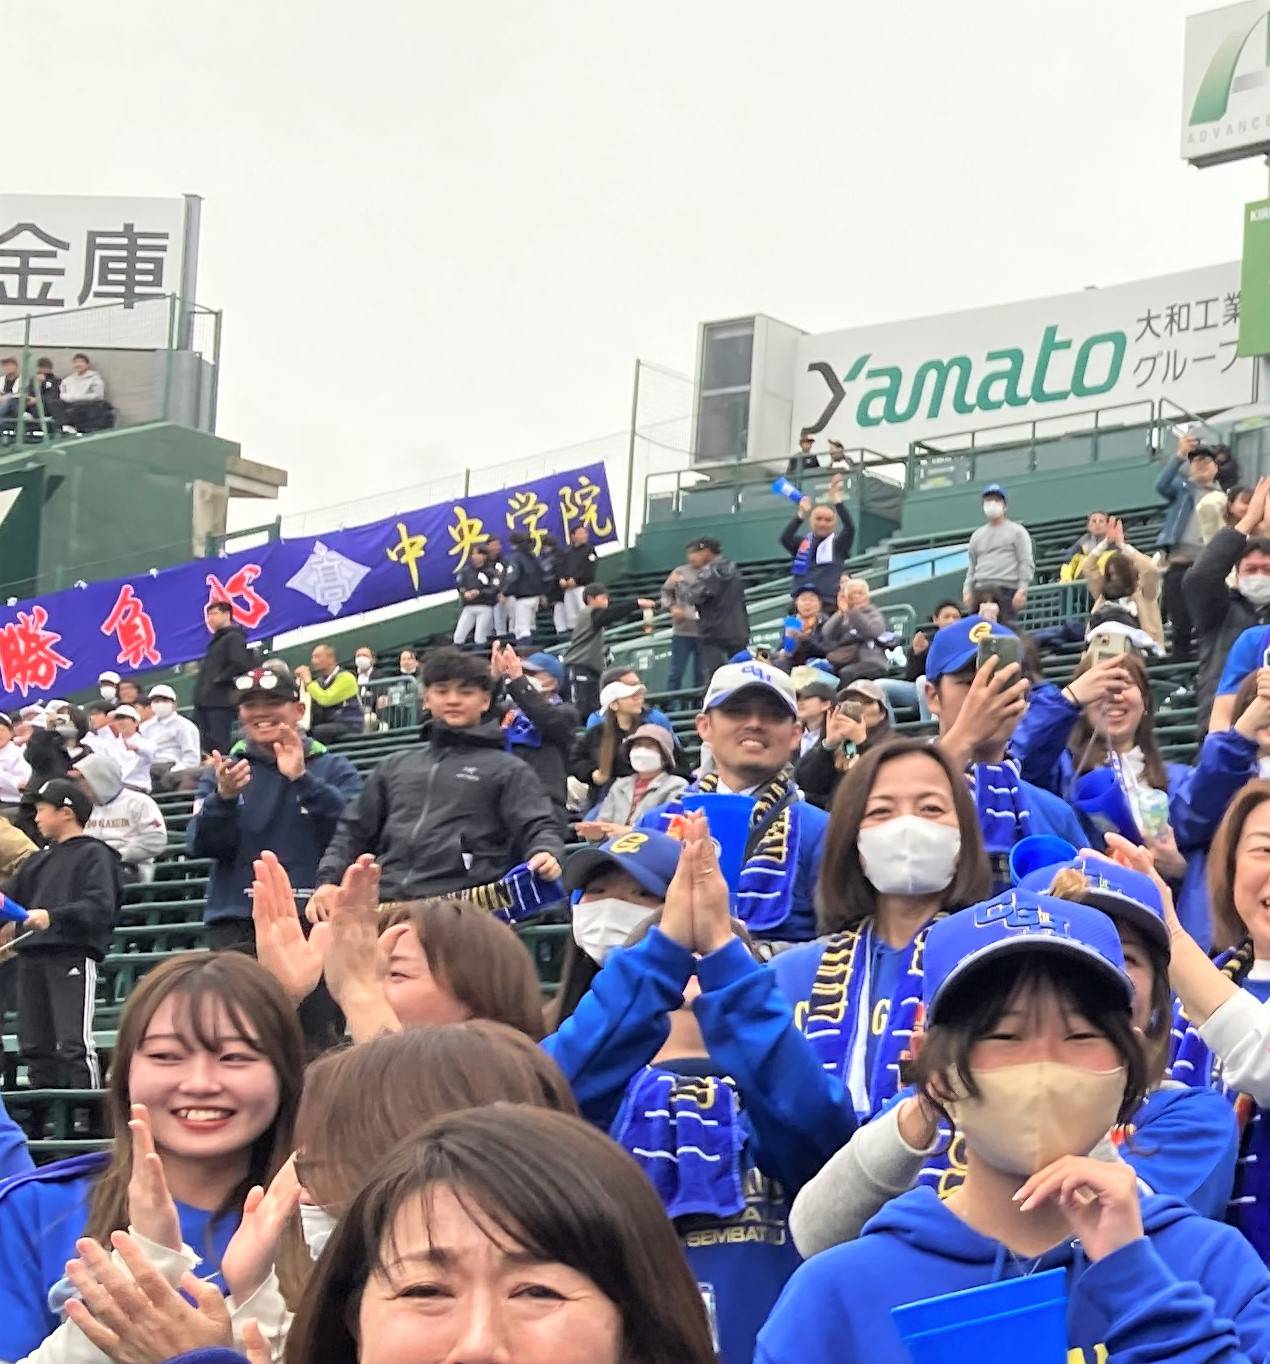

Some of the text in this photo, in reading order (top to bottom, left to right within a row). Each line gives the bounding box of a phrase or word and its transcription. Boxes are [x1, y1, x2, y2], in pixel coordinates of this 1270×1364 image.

[0, 222, 170, 309] 金庫
[1135, 291, 1240, 343] 大和工業
[386, 475, 612, 591] 中央学院
